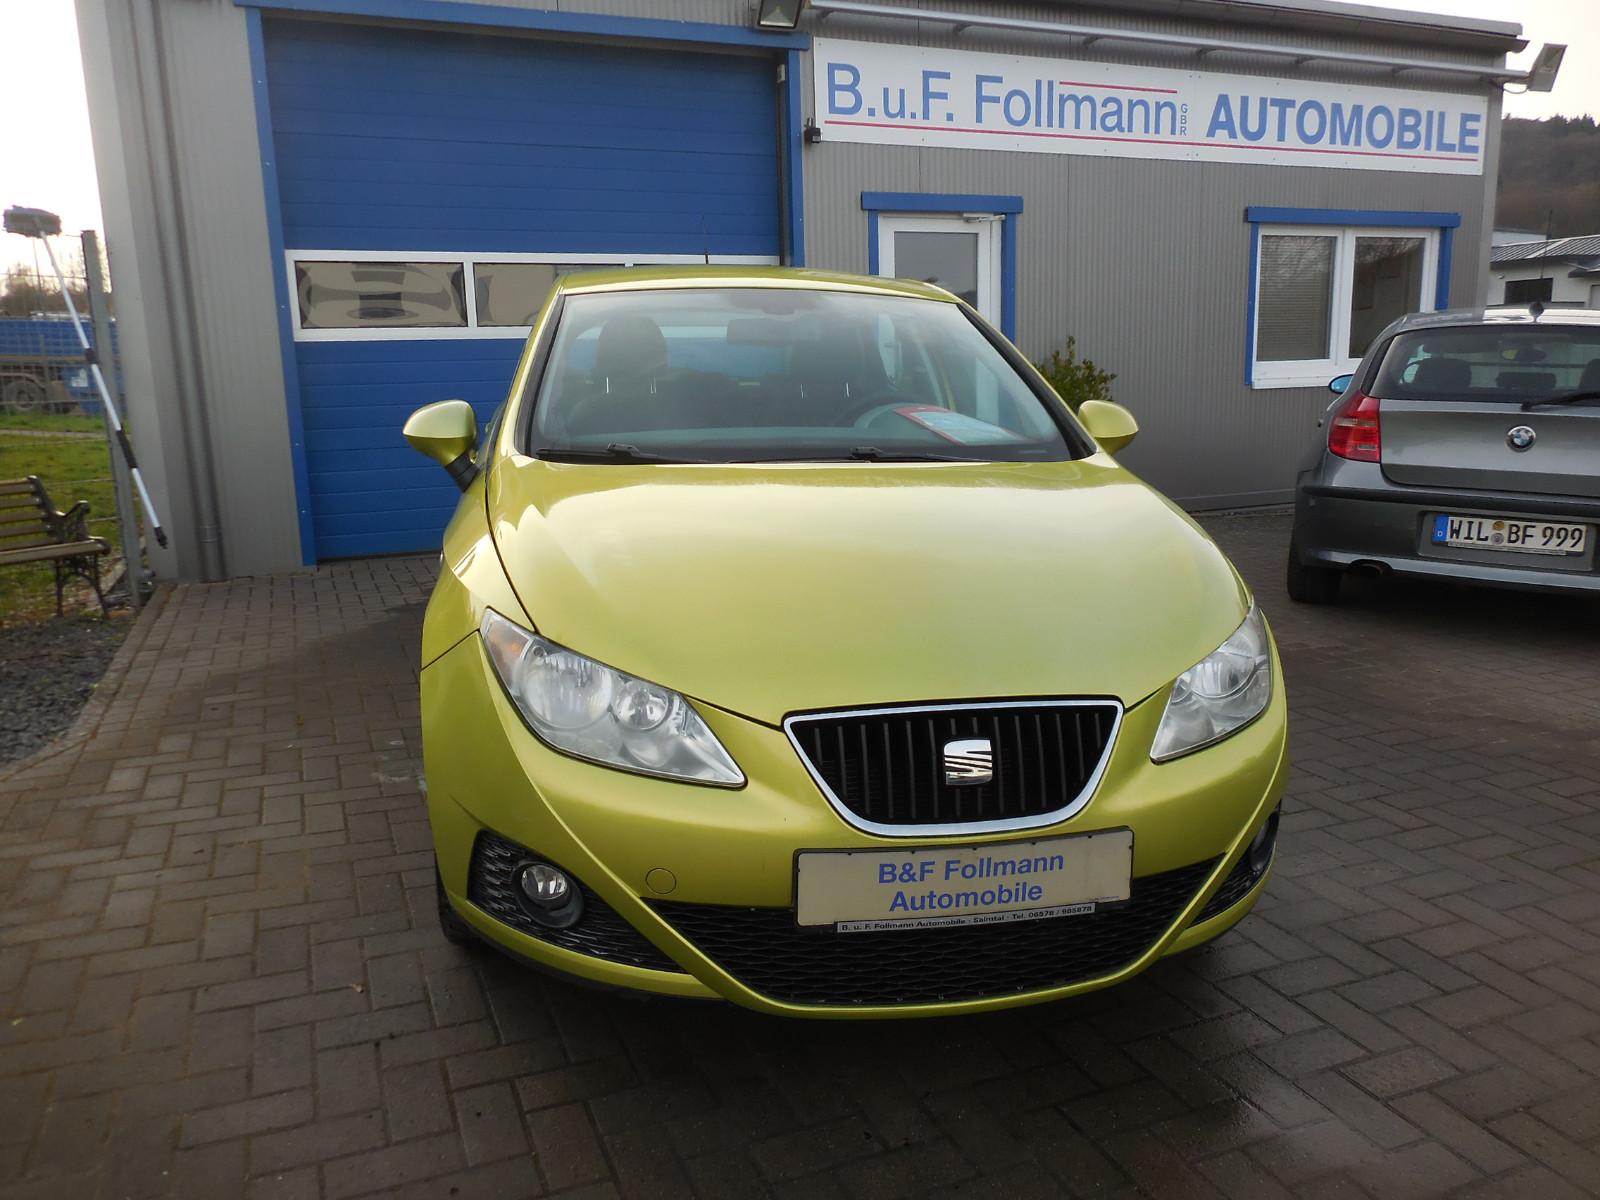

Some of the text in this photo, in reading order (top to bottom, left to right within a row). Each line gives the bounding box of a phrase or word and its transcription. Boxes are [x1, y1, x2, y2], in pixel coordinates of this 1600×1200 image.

[975, 74, 1177, 136] Follmann
[1180, 103, 1188, 137] GBR
[1206, 93, 1481, 154] AUTOMOBILE
[1449, 519, 1583, 548] WIL BF 999
[878, 854, 1064, 884] B&F Follmann
[889, 880, 1043, 912] Automobile
[874, 921, 914, 929] Follmann
[915, 918, 966, 928] Automobile
